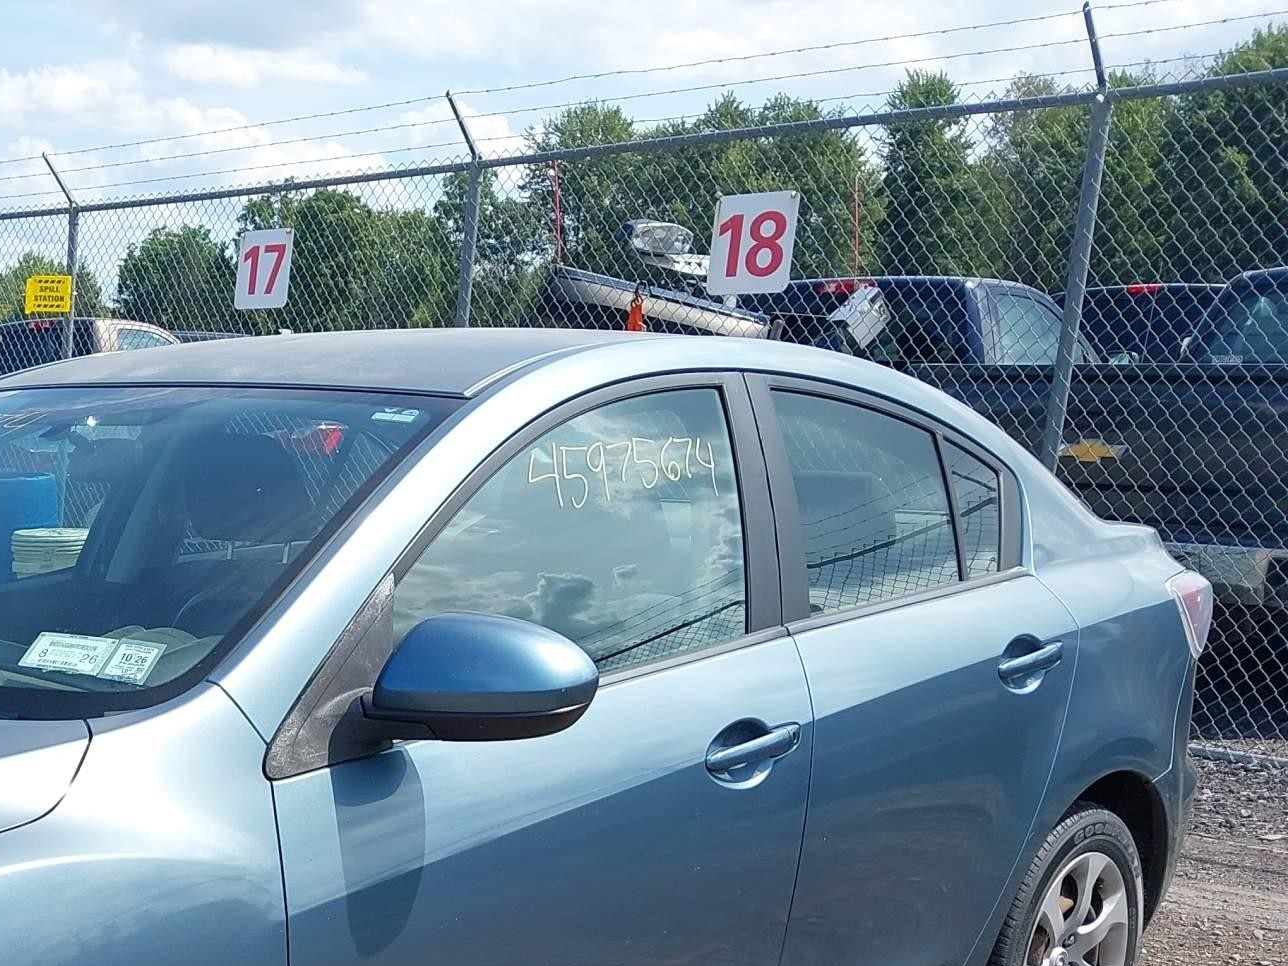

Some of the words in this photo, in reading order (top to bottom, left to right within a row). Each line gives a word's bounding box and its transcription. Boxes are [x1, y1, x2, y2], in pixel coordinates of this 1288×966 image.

[719, 208, 787, 278] 18
[242, 243, 286, 296] 17
[33, 294, 65, 303] STATION
[39, 285, 61, 293] SPILL
[527, 436, 719, 509] 45975674
[78, 653, 99, 665] 26
